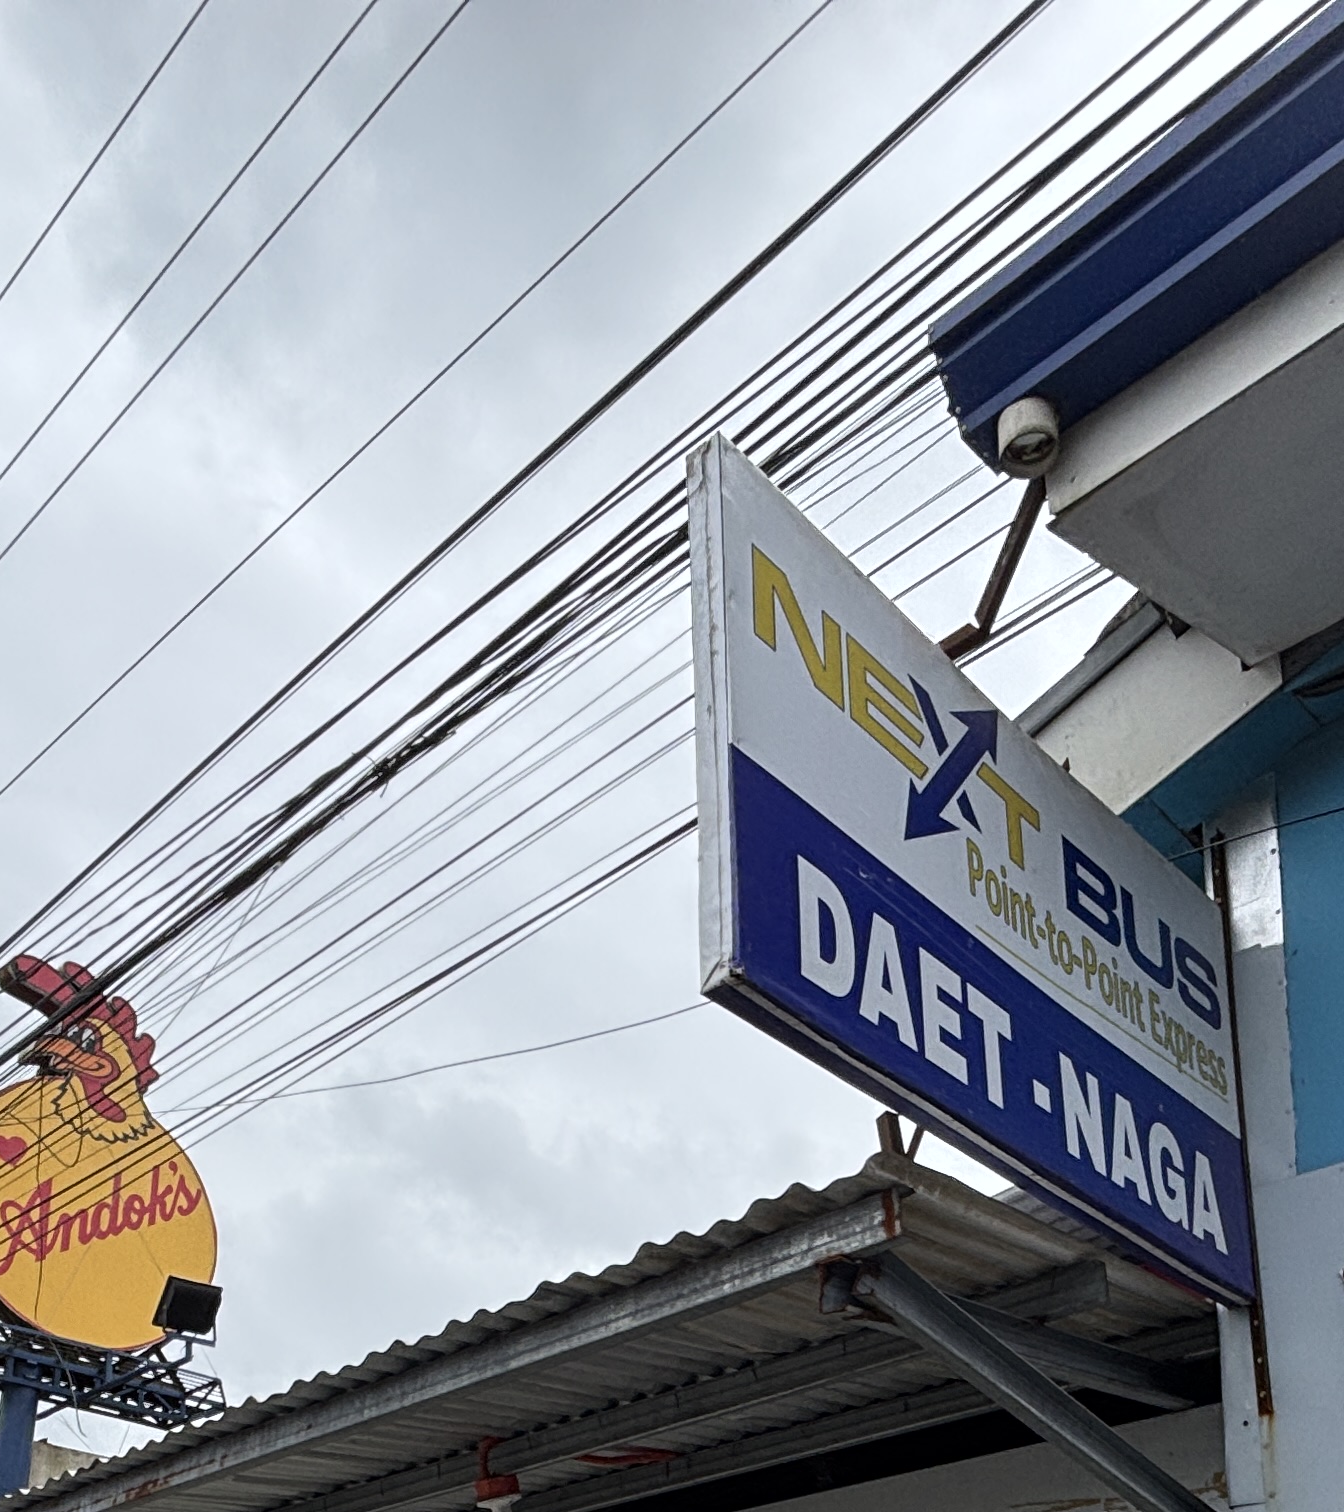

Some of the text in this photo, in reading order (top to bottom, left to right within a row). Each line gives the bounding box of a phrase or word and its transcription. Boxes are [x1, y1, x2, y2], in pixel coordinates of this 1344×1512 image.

[751, 542, 1222, 1030] NEXT BUS
[966, 837, 1228, 1096] Point-to-Point Express
[796, 853, 1013, 1110] DAET
[1058, 1050, 1229, 1256] NAGA
